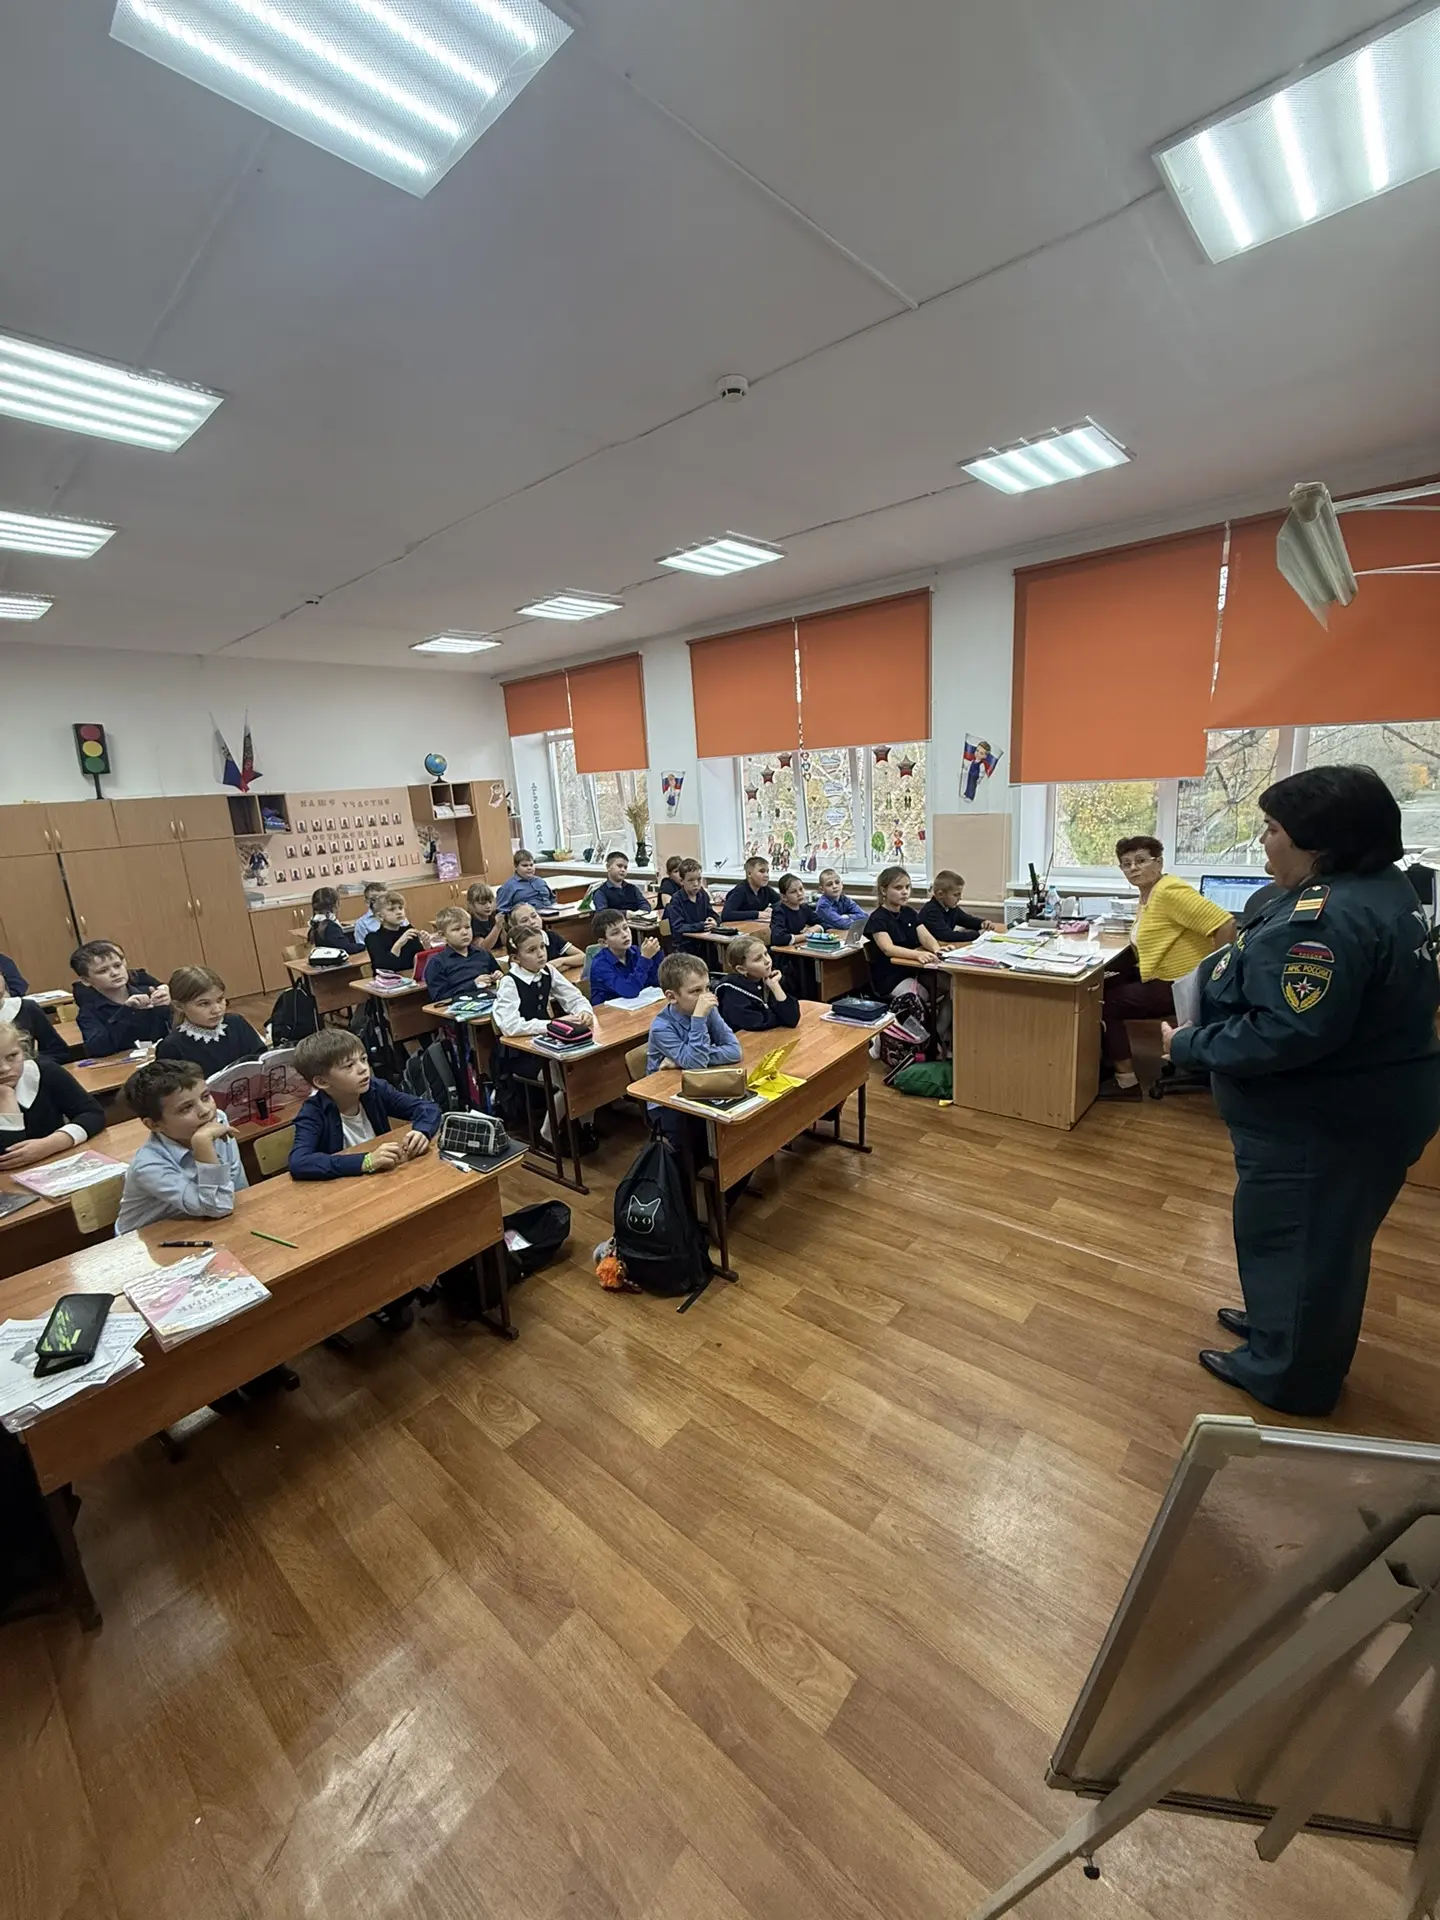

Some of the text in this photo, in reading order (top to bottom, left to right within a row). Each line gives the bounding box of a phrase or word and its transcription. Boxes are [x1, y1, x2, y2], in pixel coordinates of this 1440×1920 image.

[342, 798, 390, 808] УЧАСТИЕ
[305, 829, 379, 843] ДОСТИЖЕНИЯ
[1287, 964, 1329, 977] МЧС РОССИИ
